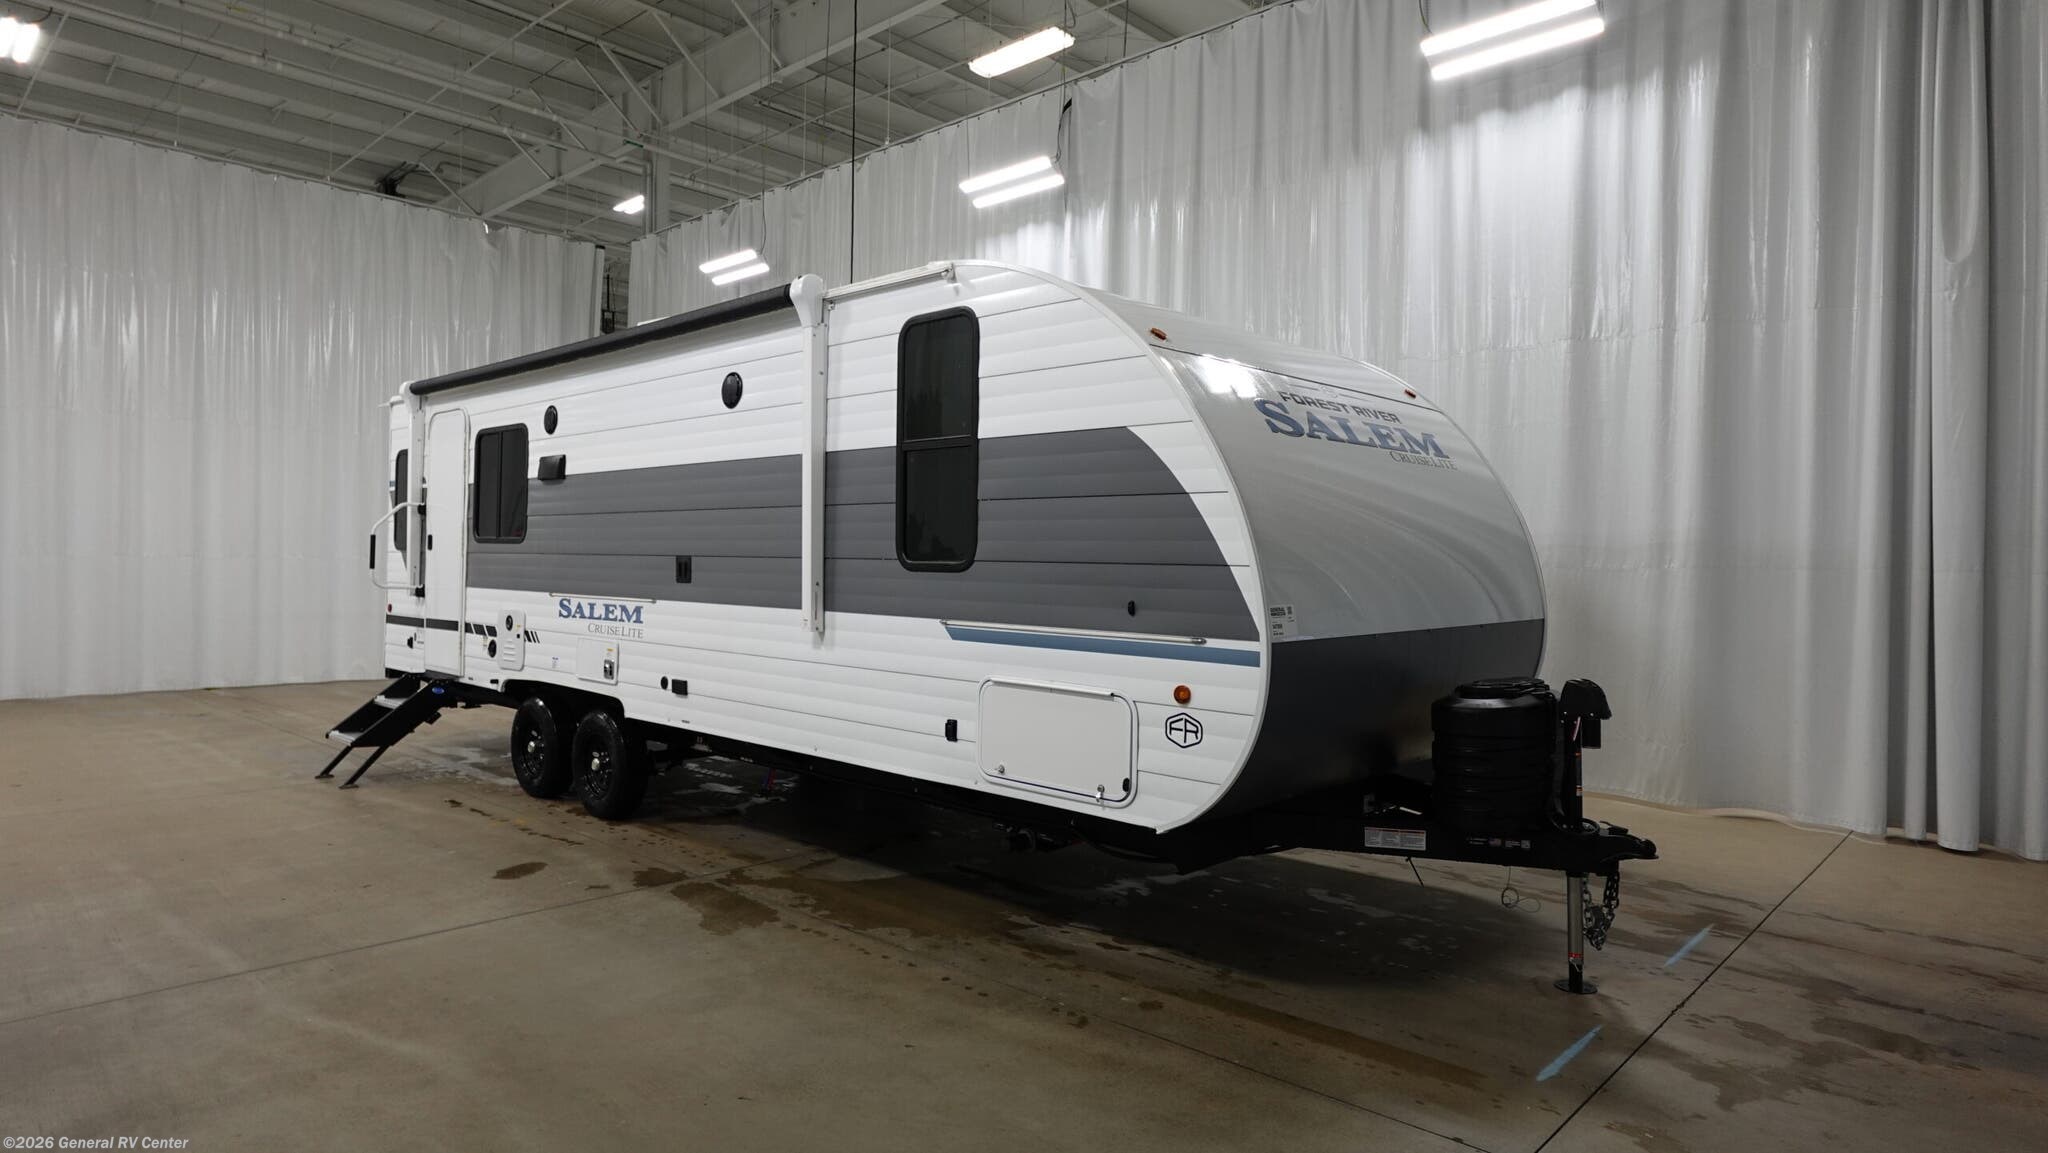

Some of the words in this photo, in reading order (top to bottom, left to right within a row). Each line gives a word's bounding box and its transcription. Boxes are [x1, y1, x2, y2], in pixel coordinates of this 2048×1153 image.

[1278, 391, 1350, 414] FOREST
[1351, 405, 1402, 424] RIVER
[1254, 398, 1450, 459] SALEM
[559, 598, 644, 624] SALEM
